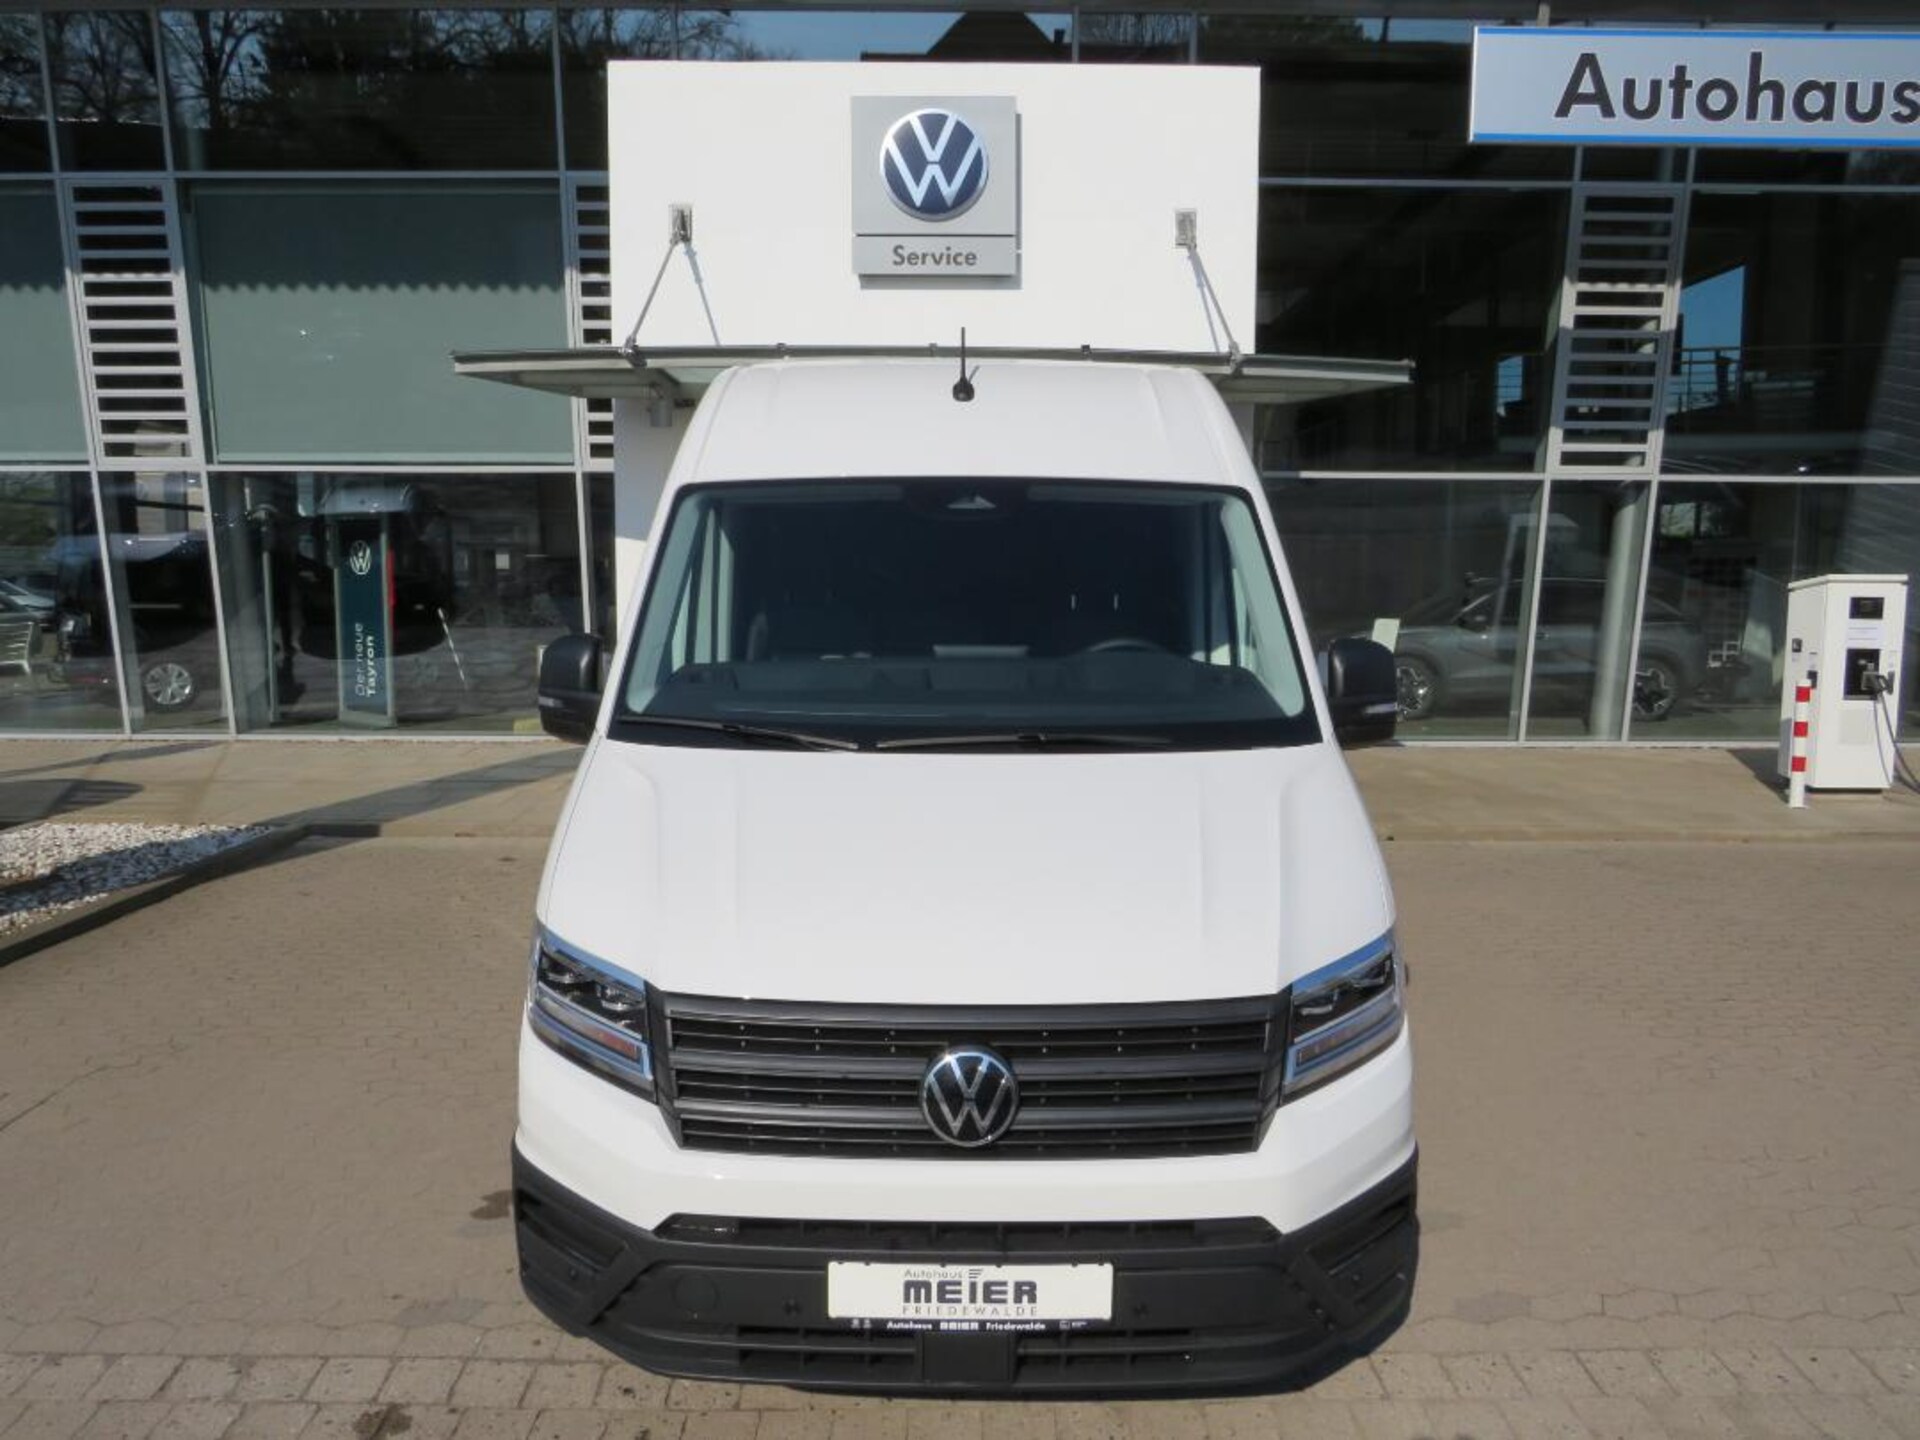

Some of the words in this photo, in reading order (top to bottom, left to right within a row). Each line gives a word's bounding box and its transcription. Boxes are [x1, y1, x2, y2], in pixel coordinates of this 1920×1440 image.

[1553, 50, 1920, 124] Autohaus
[881, 109, 988, 220] VW
[892, 244, 978, 267] Service
[355, 623, 364, 664] neue
[366, 636, 377, 698] Tayron
[922, 1051, 1018, 1147] VW
[904, 1269, 964, 1280] Autohaus
[902, 1280, 1038, 1304] MEIER
[886, 1320, 934, 1330] Autohaus
[985, 1321, 1047, 1331] Friedewalde
[902, 1306, 1038, 1317] FRIEDEWALDE
